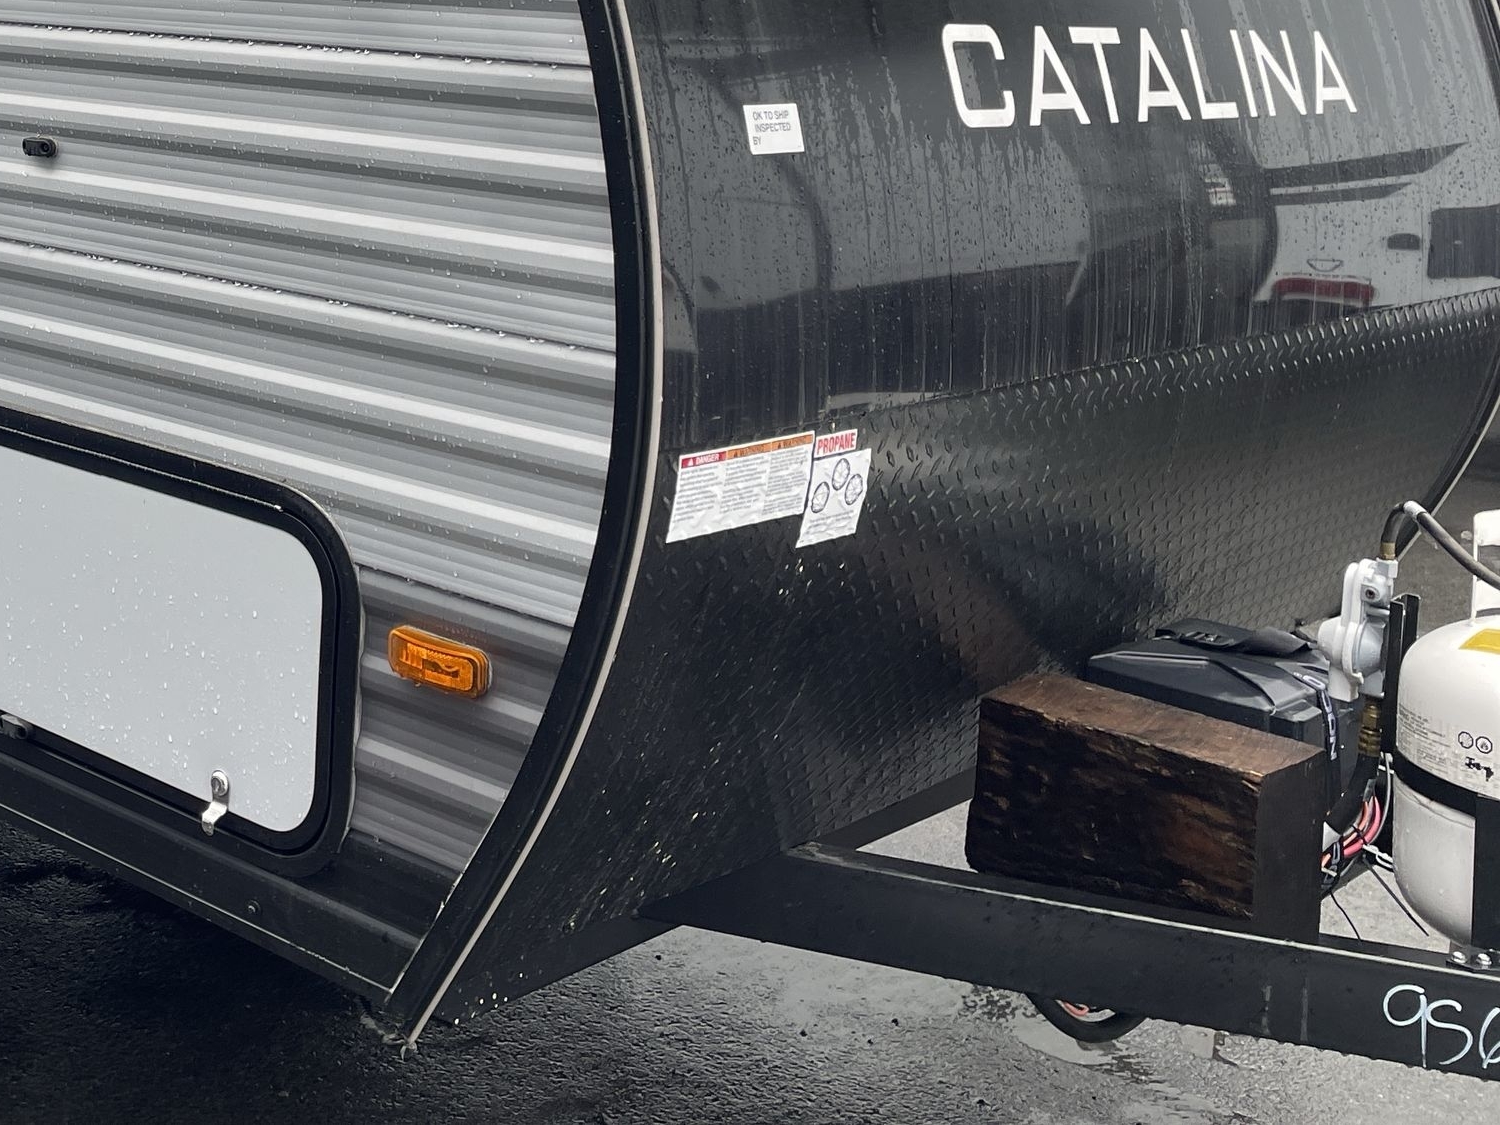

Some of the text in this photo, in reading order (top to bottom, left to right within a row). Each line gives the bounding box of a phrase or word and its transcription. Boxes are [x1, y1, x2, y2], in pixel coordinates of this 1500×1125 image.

[942, 23, 1358, 128] CATALINA
[753, 110, 789, 121] OK TO SHIP
[755, 122, 792, 133] INSPECTED
[753, 136, 762, 145] BY
[816, 432, 856, 456] PROPANE
[695, 453, 720, 467] DANGER
